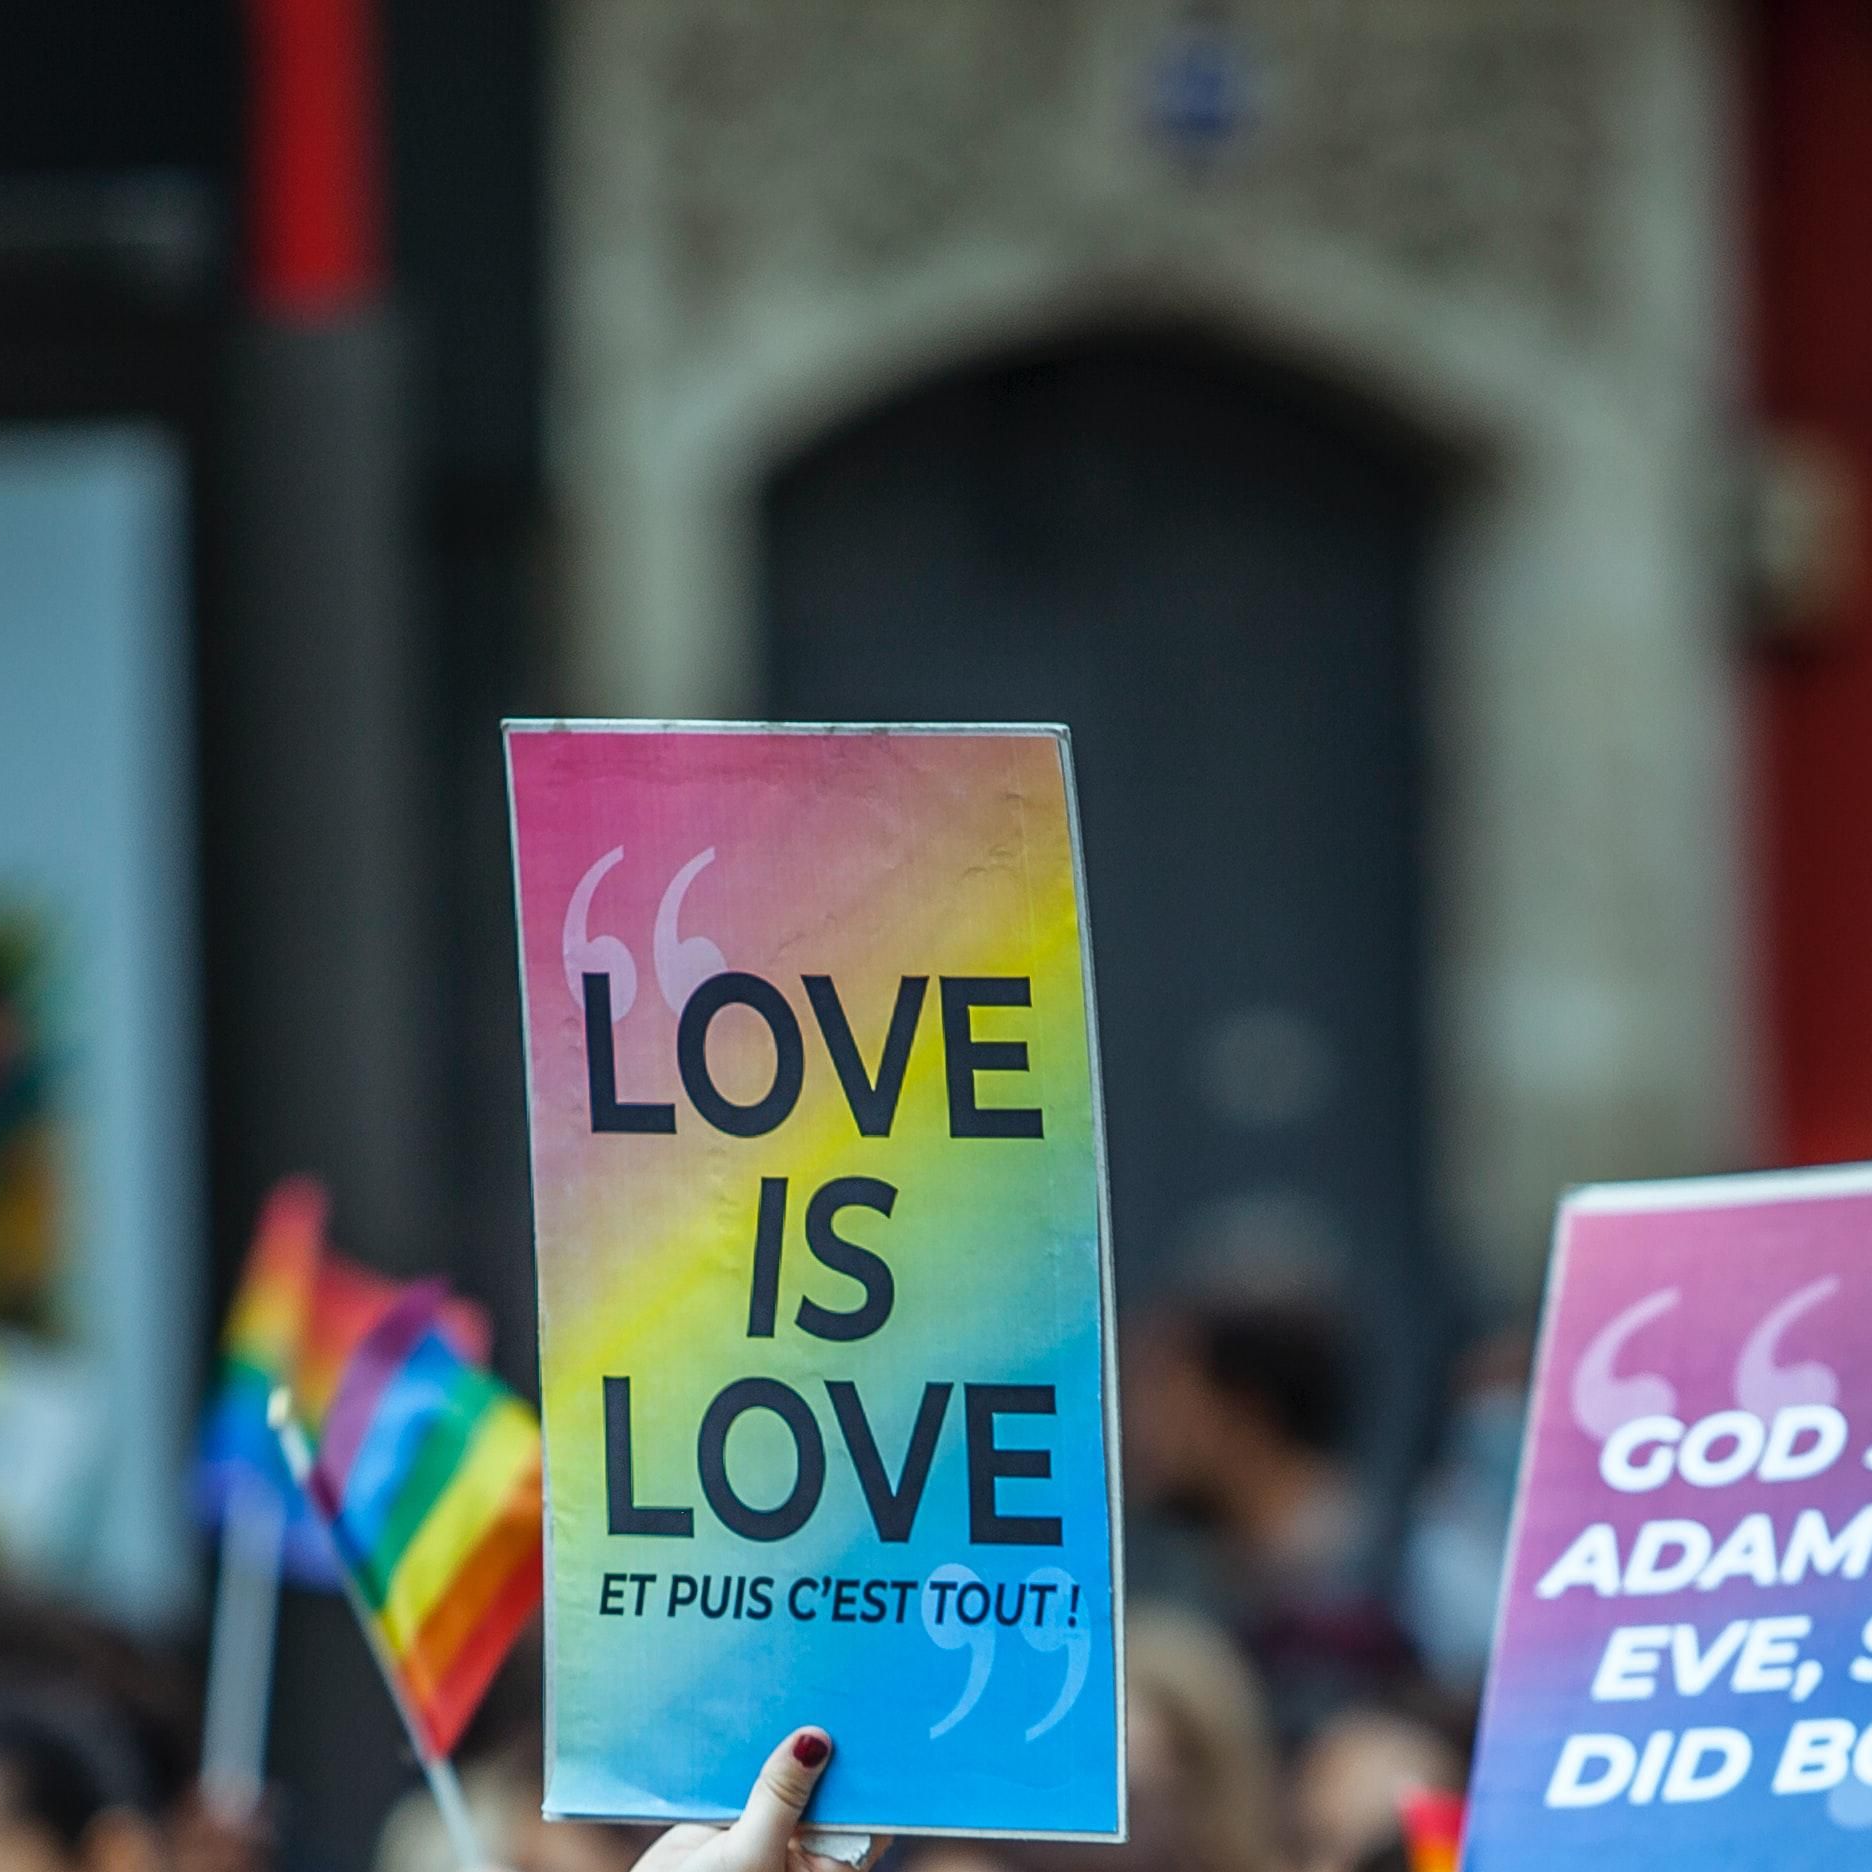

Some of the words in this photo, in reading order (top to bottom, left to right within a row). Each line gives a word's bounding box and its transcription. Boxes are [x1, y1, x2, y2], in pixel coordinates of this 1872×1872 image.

[582, 972, 1044, 1139] LOVE
[746, 1176, 898, 1342] IS
[603, 1375, 1063, 1547] LOVE
[1600, 1403, 1848, 1493] GOD
[599, 1573, 657, 1616] ET
[667, 1574, 775, 1620] PUIS
[788, 1575, 918, 1624] C'EST
[1590, 1614, 1822, 1702] EVE,
[1544, 1726, 1752, 1809] DID
